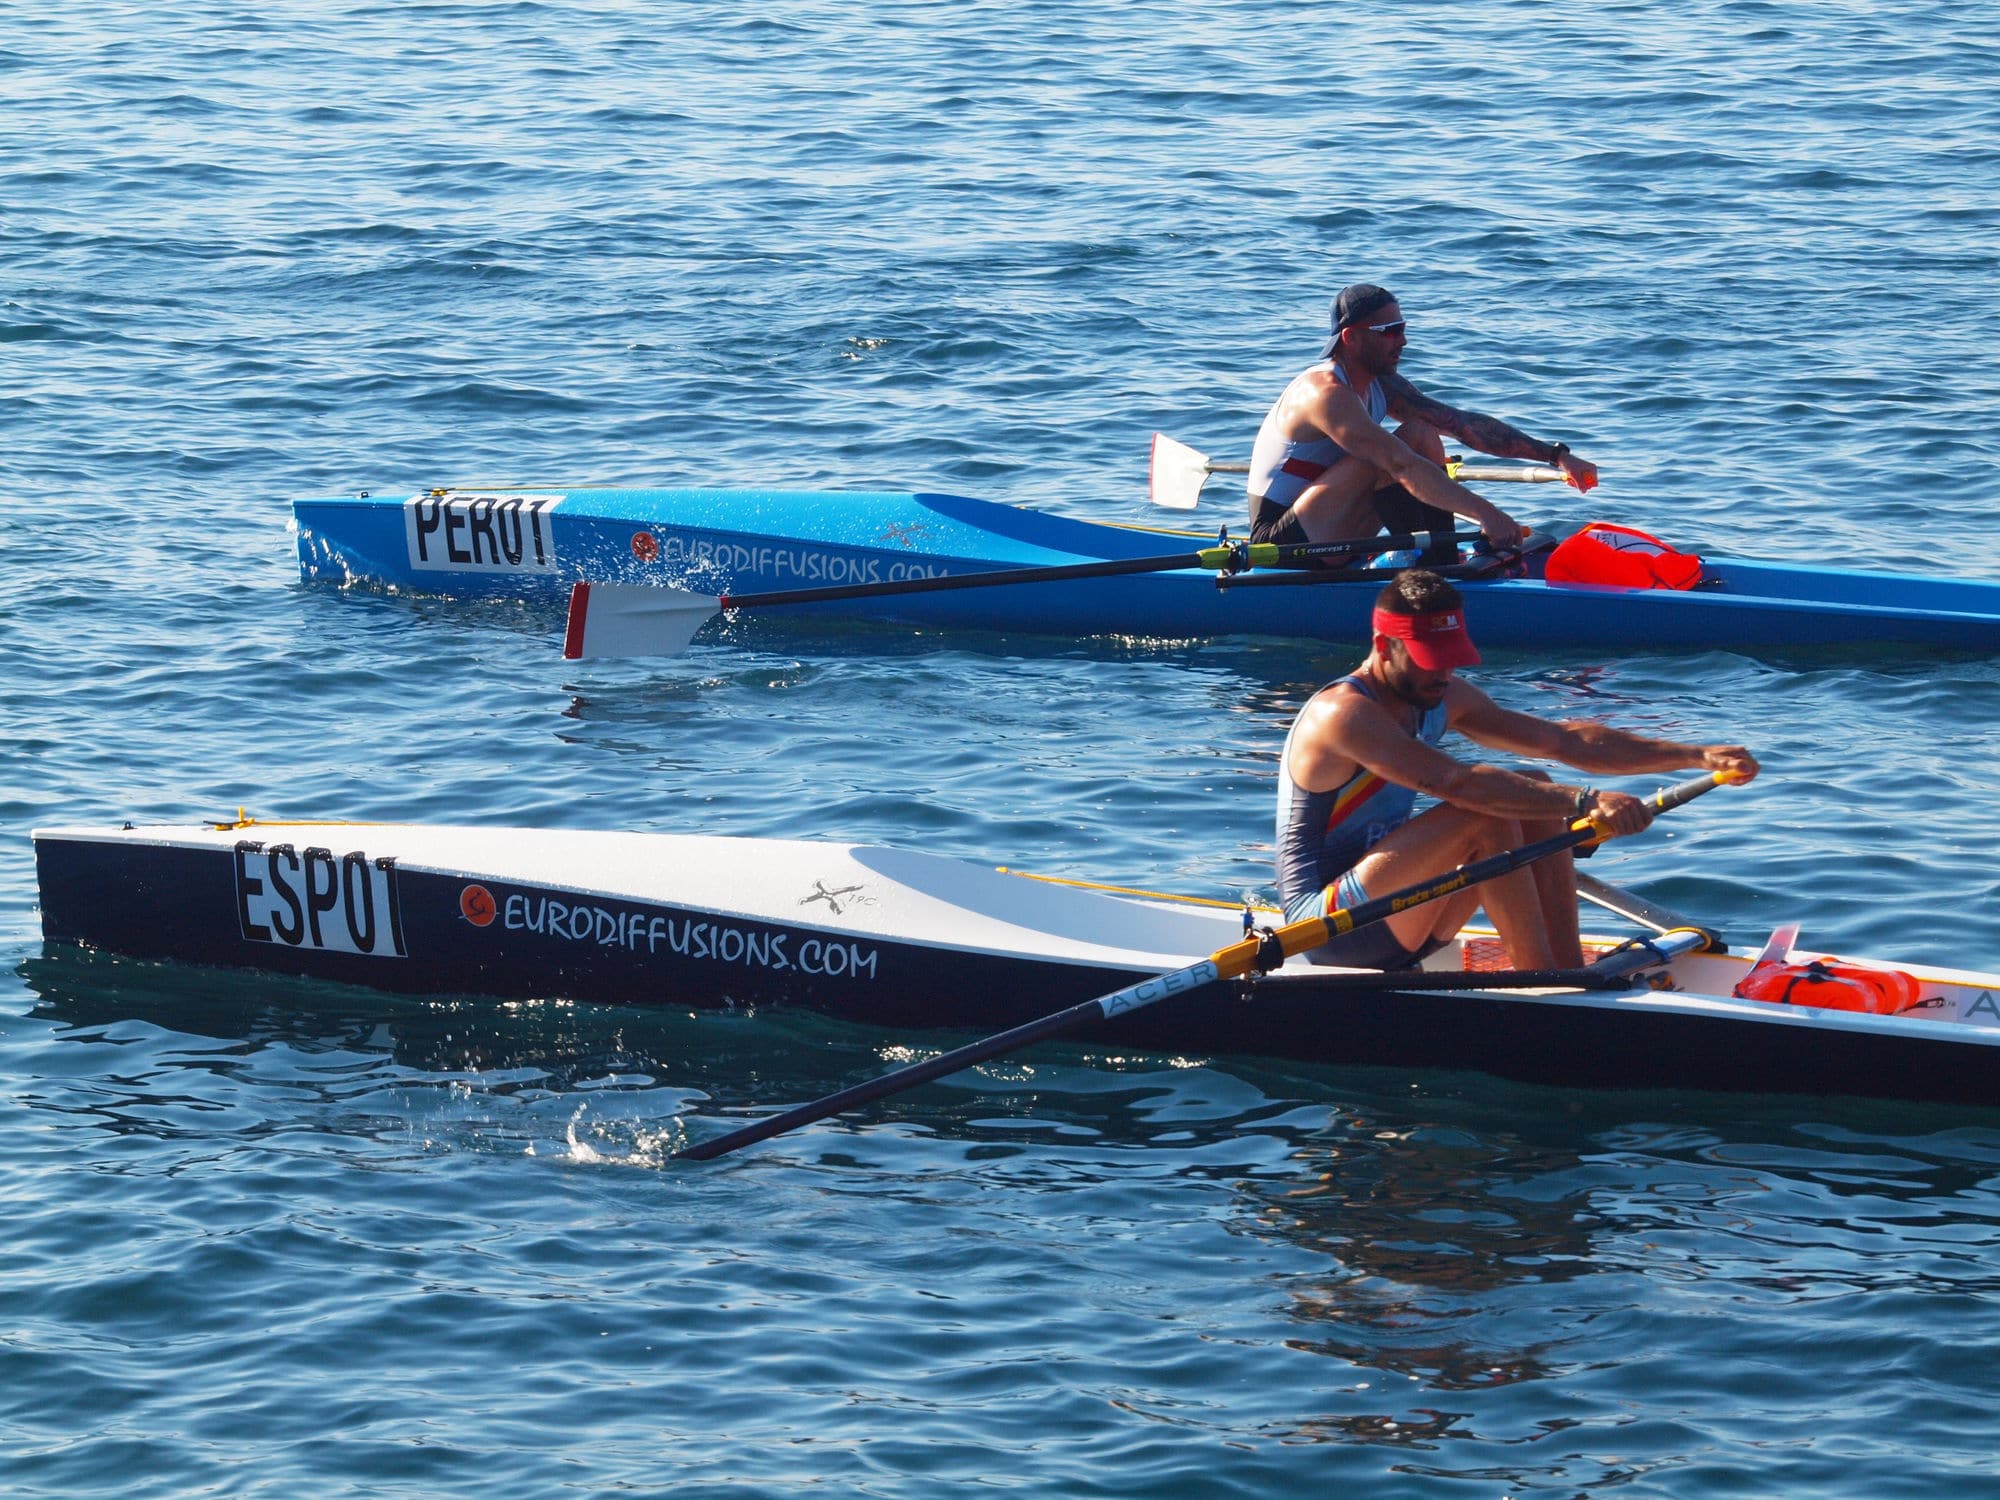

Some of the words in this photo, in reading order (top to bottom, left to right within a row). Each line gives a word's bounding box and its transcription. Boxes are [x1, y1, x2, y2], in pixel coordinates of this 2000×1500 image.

[414, 496, 551, 566] PER01
[663, 536, 948, 583] EURODIFFUSIONSCOM
[234, 839, 407, 956] ESP01
[504, 894, 877, 979] EURODIFFUSIONS.COM
[1109, 963, 1213, 1014] ACER
